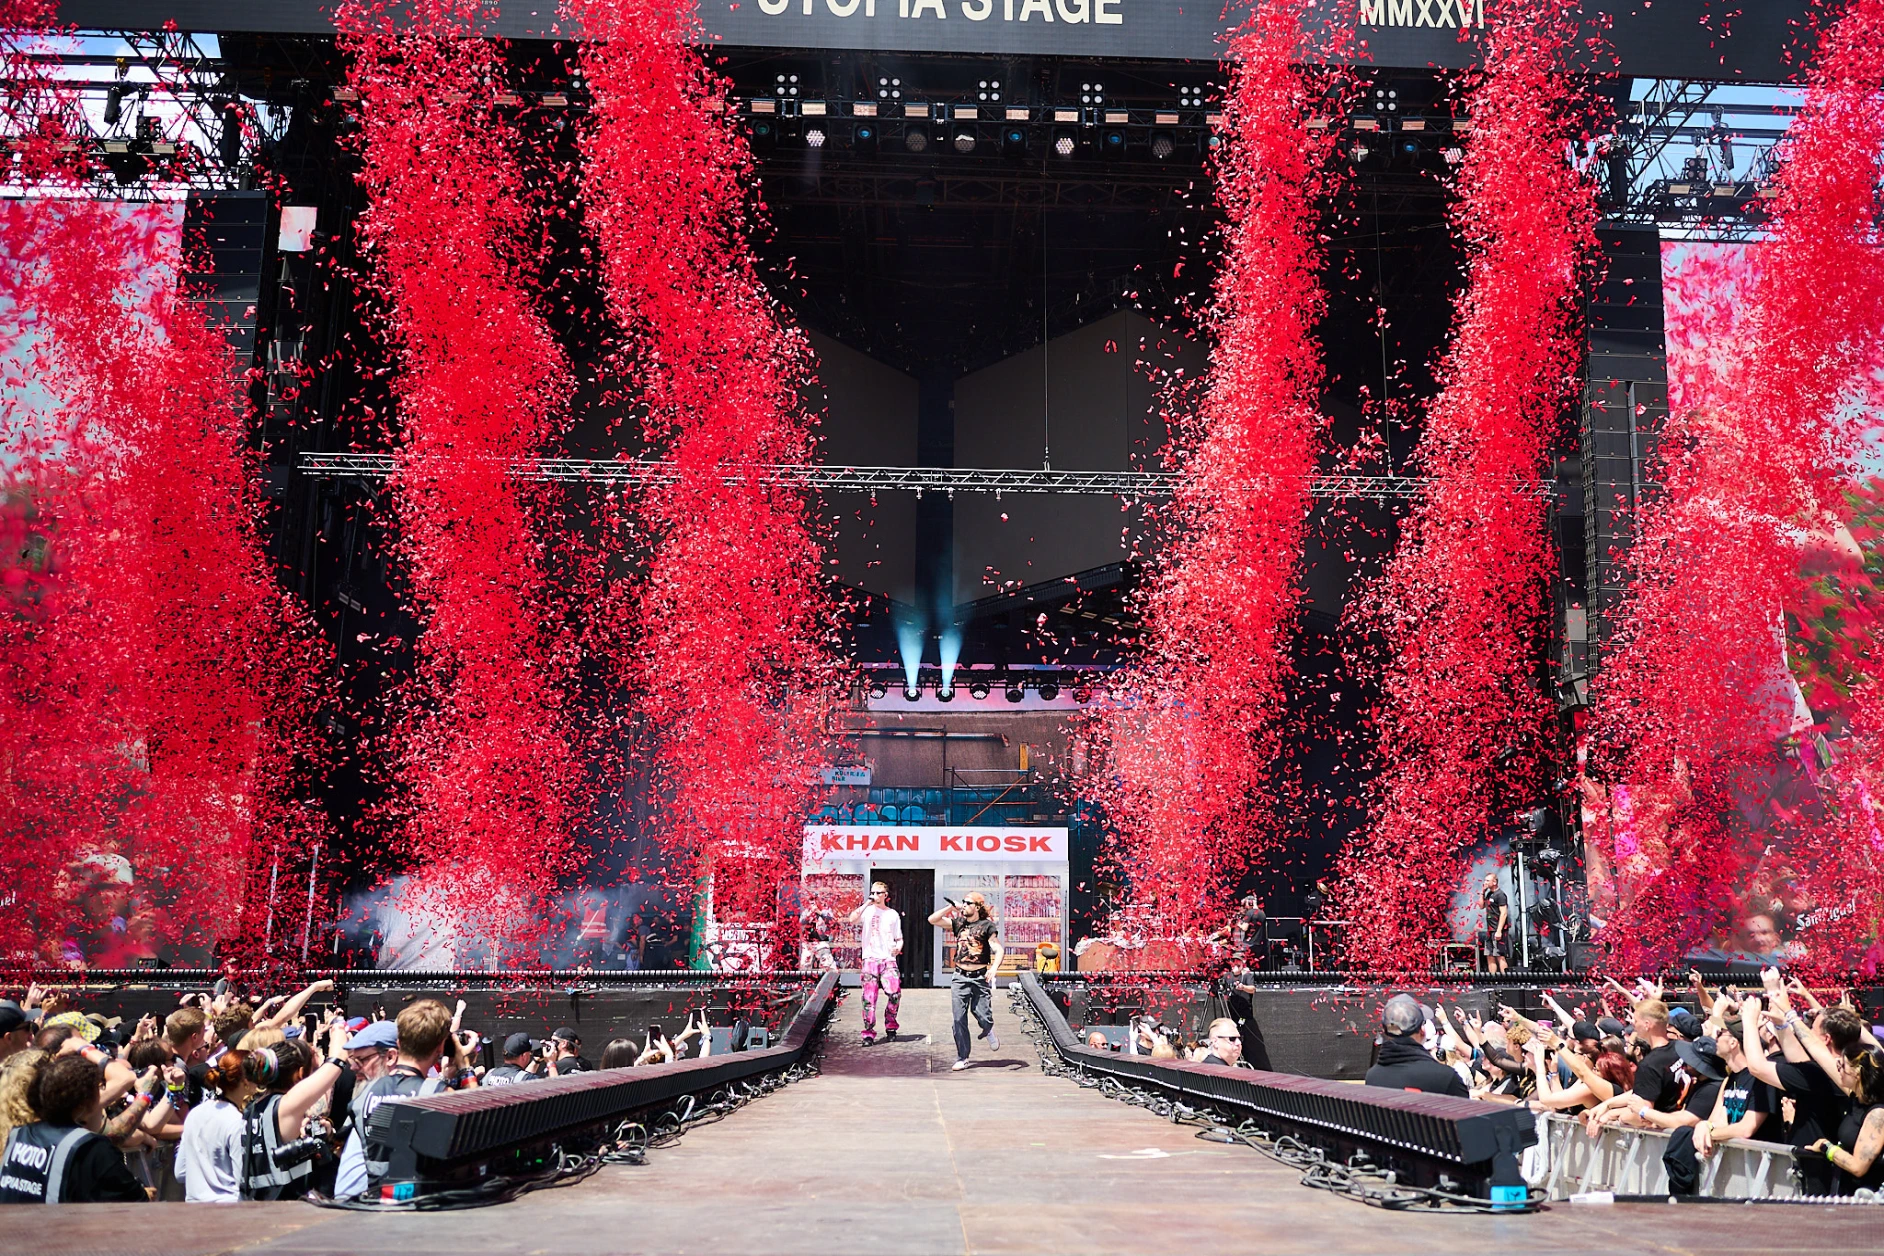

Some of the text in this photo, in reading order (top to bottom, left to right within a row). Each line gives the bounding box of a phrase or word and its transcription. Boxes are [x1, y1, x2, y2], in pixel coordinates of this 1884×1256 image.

[1359, 0, 1485, 29] MMXXVI
[820, 834, 1053, 852] KHAN KIOSK
[19, 1179, 42, 1195] STAGE
